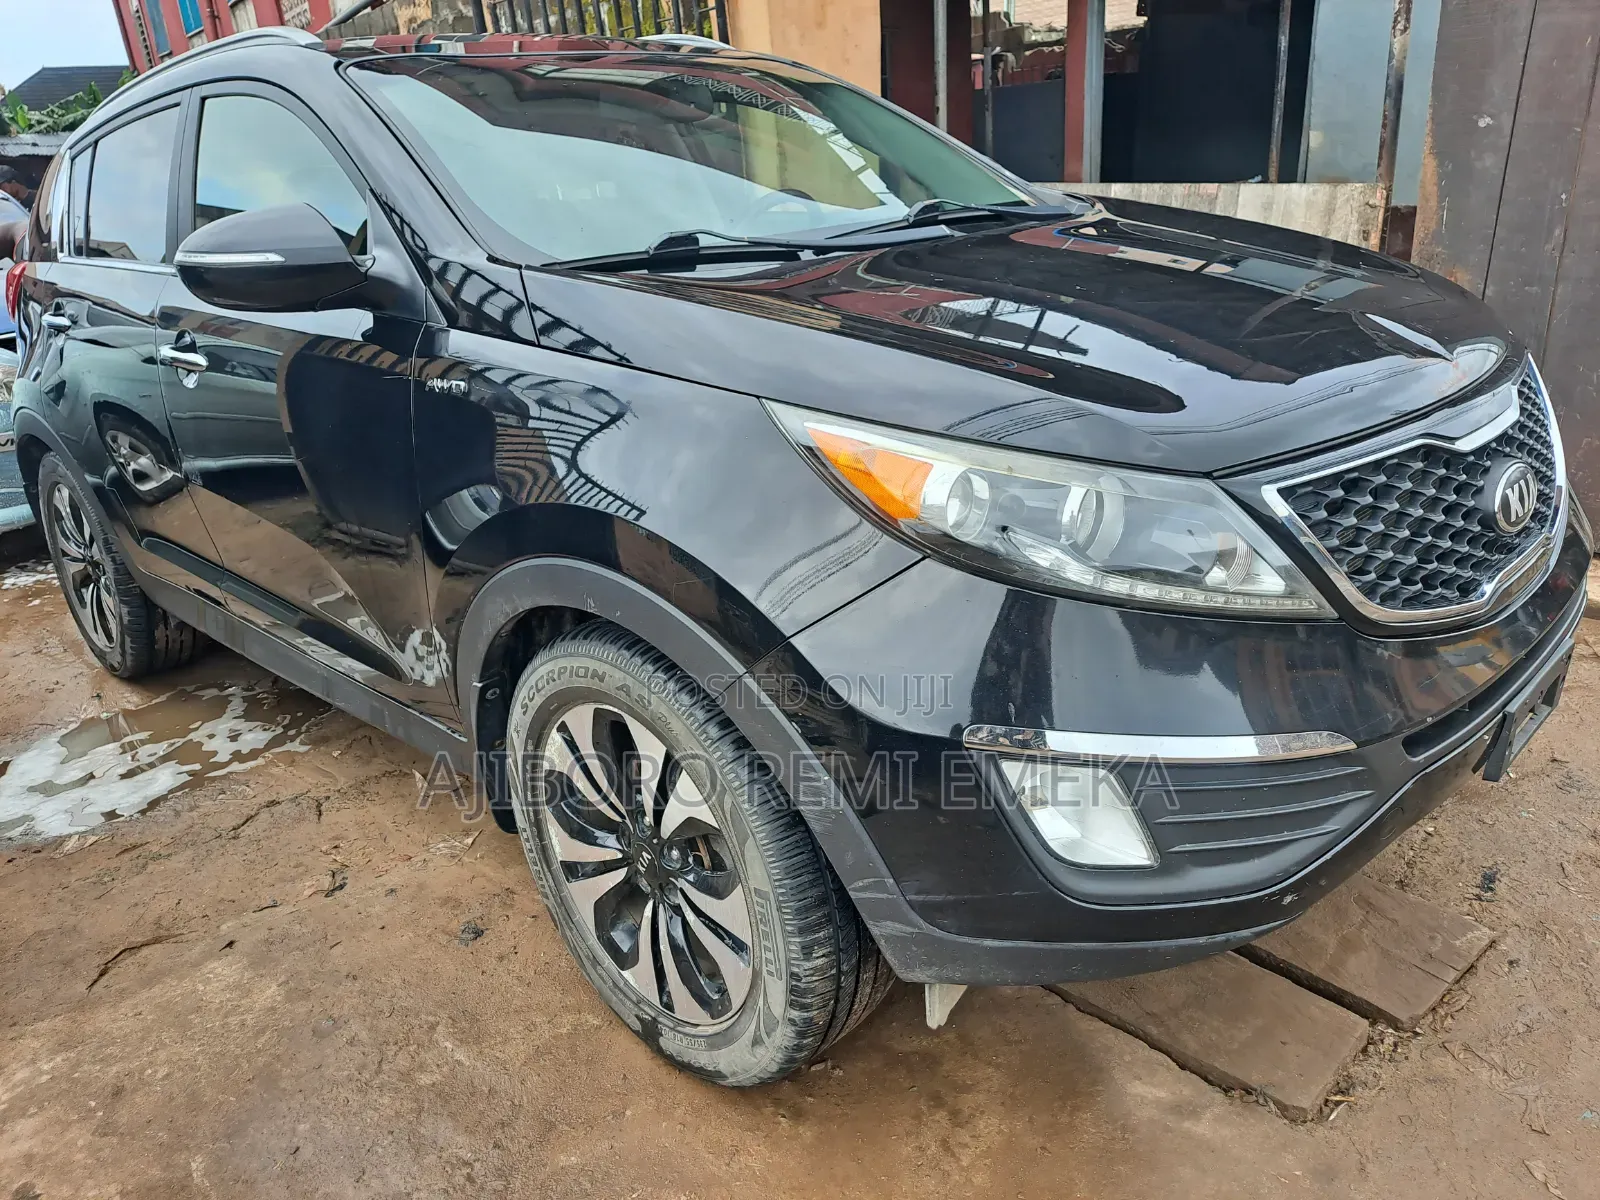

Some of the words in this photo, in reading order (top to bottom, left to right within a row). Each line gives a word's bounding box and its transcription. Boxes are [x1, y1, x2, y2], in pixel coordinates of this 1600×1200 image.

[425, 378, 466, 394] AWD
[520, 665, 607, 717] SCORPION
[636, 851, 652, 875] KIA
[753, 886, 783, 982] PIRELLI
